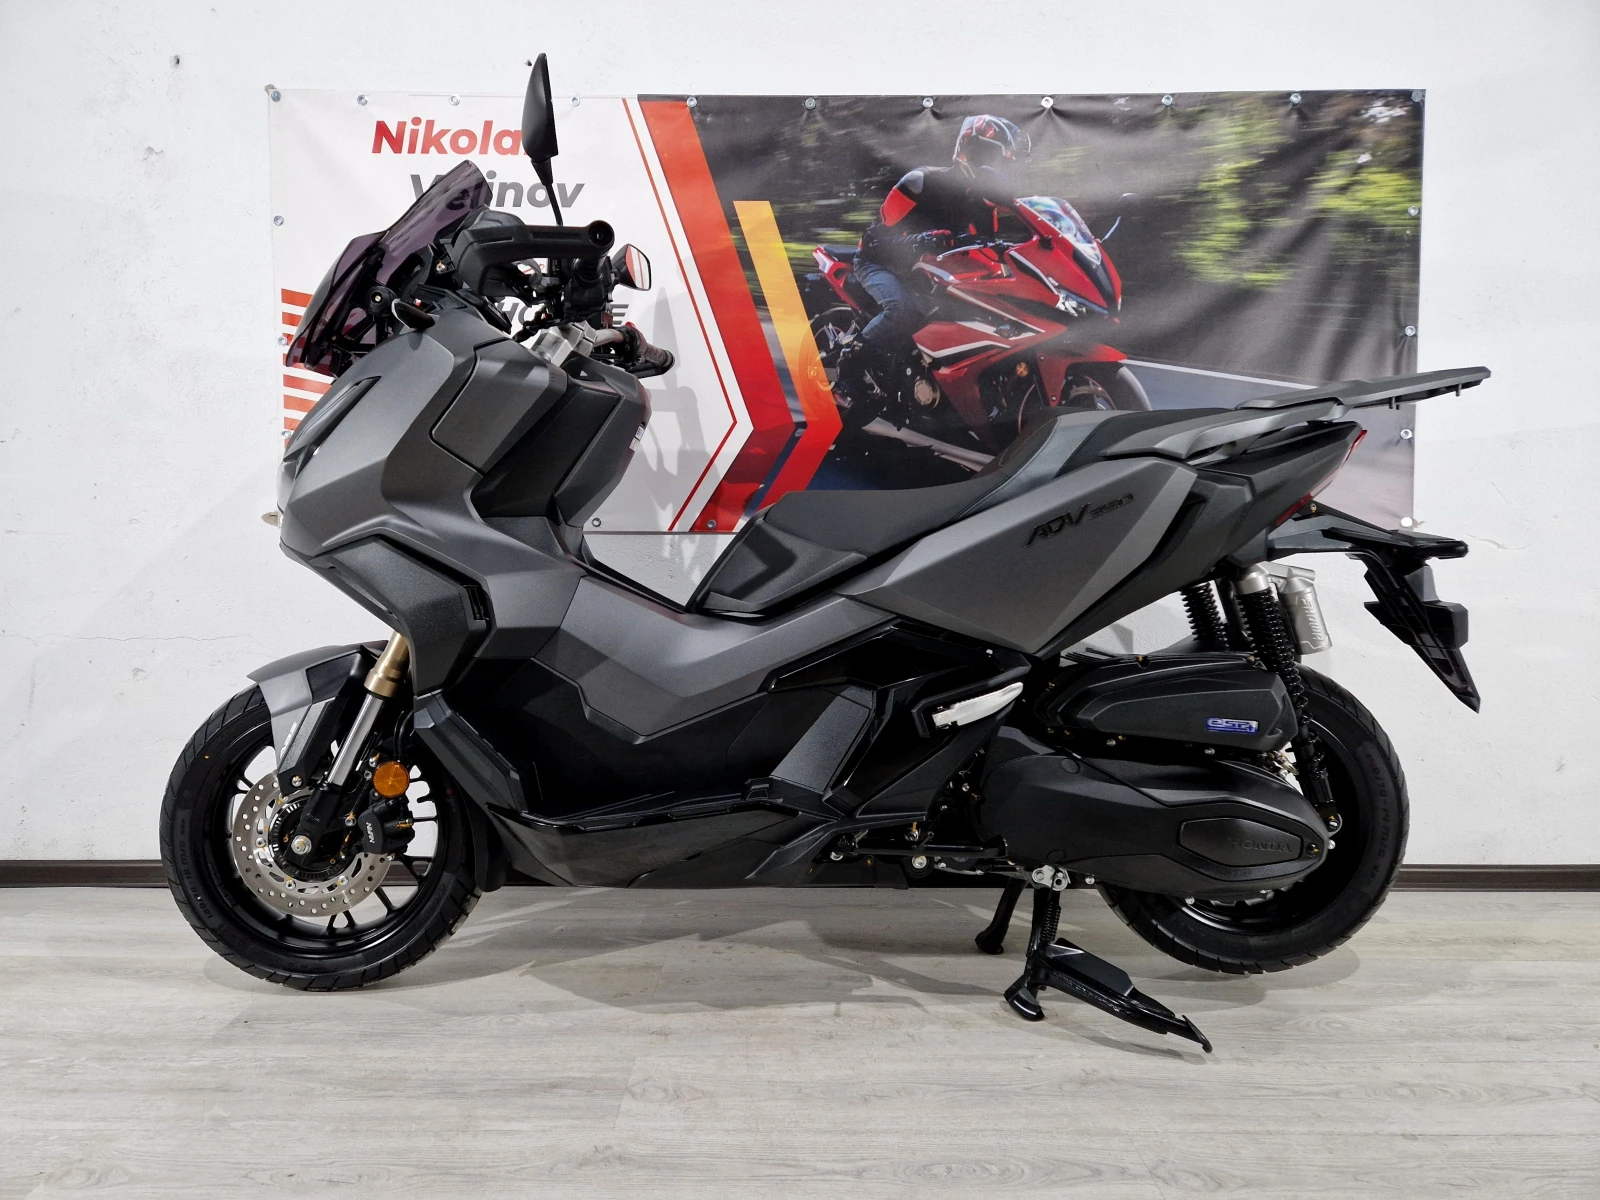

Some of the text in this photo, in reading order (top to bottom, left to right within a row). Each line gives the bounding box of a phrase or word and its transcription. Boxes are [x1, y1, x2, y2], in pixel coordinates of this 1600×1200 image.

[372, 116, 529, 155] Nikola
[410, 169, 585, 209] Vinov
[1024, 502, 1091, 547] ADV
